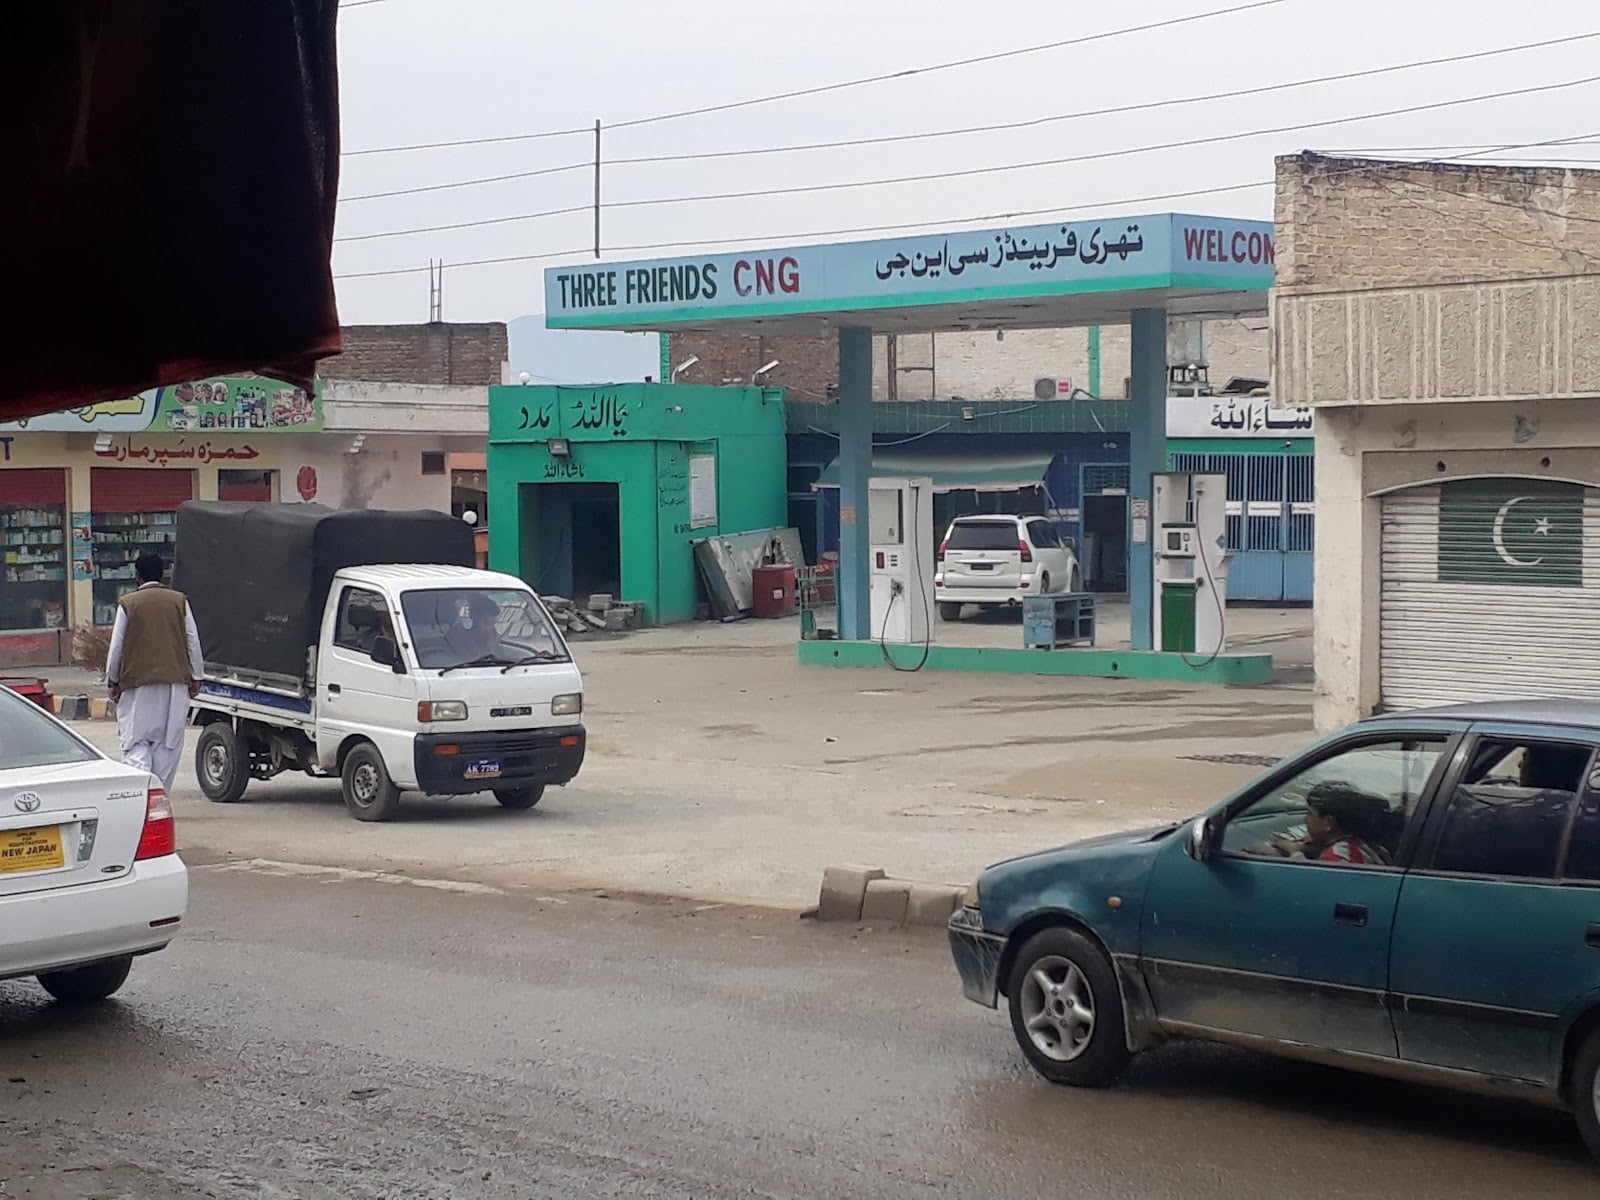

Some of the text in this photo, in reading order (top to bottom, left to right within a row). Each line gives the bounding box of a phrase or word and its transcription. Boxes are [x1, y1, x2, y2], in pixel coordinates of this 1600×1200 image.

[1079, 223, 1143, 265] تھری
[557, 257, 800, 309] THREE FRIENDS CNG
[1, 847, 24, 858] NEW
[26, 844, 57, 855] JAPAN
